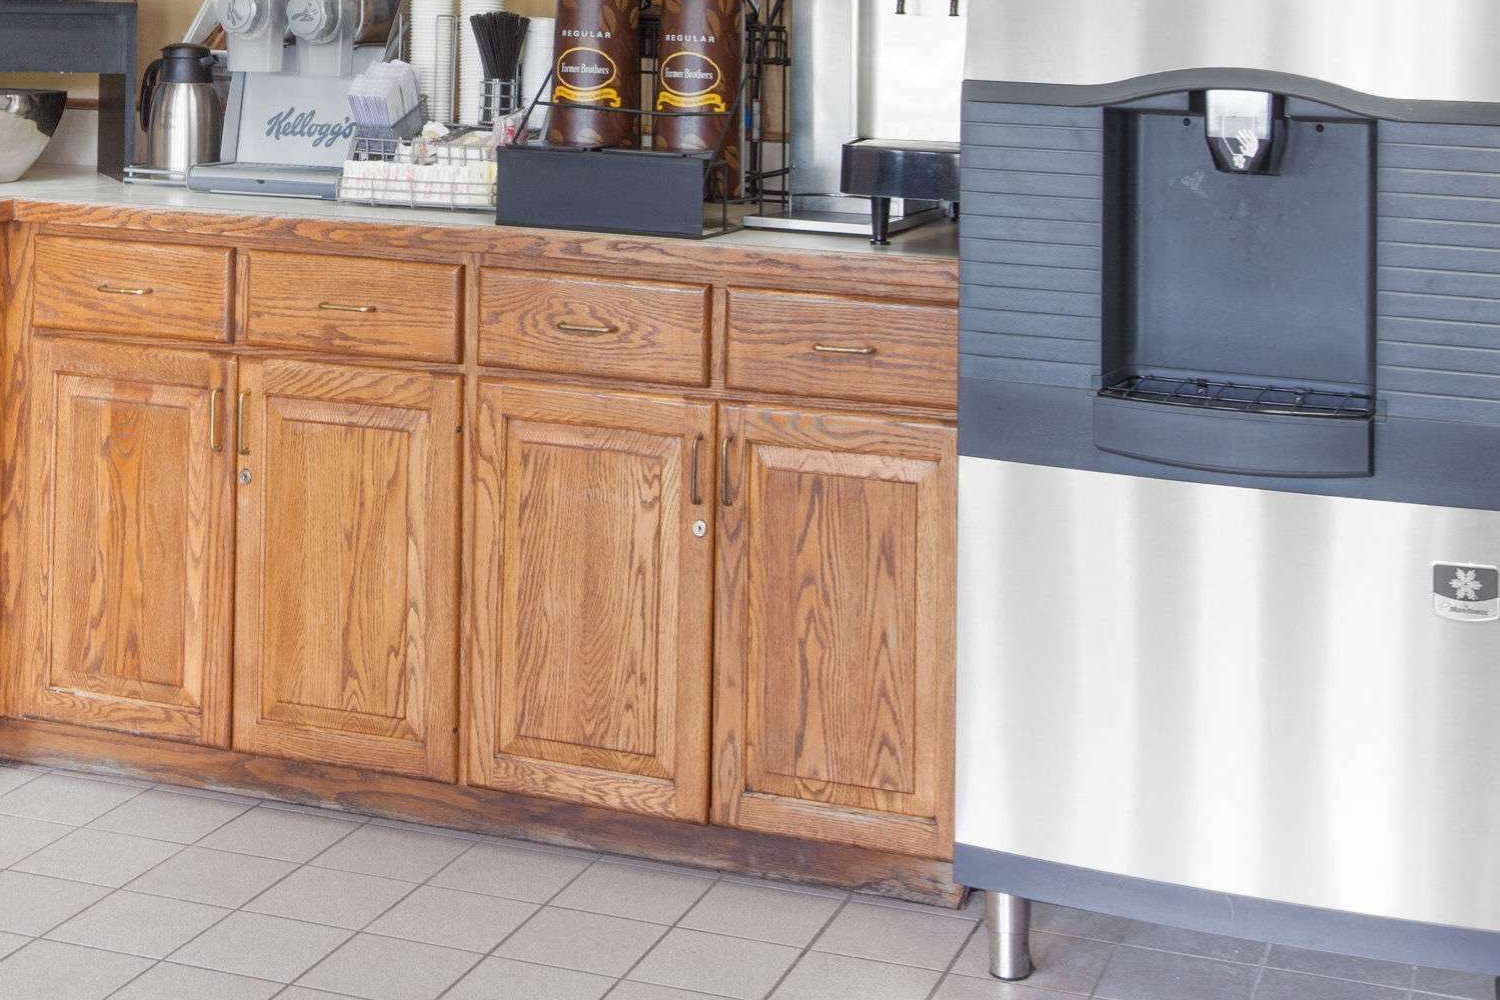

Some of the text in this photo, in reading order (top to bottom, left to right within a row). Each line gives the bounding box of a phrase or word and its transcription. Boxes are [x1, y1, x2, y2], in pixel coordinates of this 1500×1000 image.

[561, 29, 612, 38] REGULAR
[665, 34, 716, 43] REGULAR
[580, 63, 609, 75] Brothers
[265, 106, 357, 148] Kellogg's
